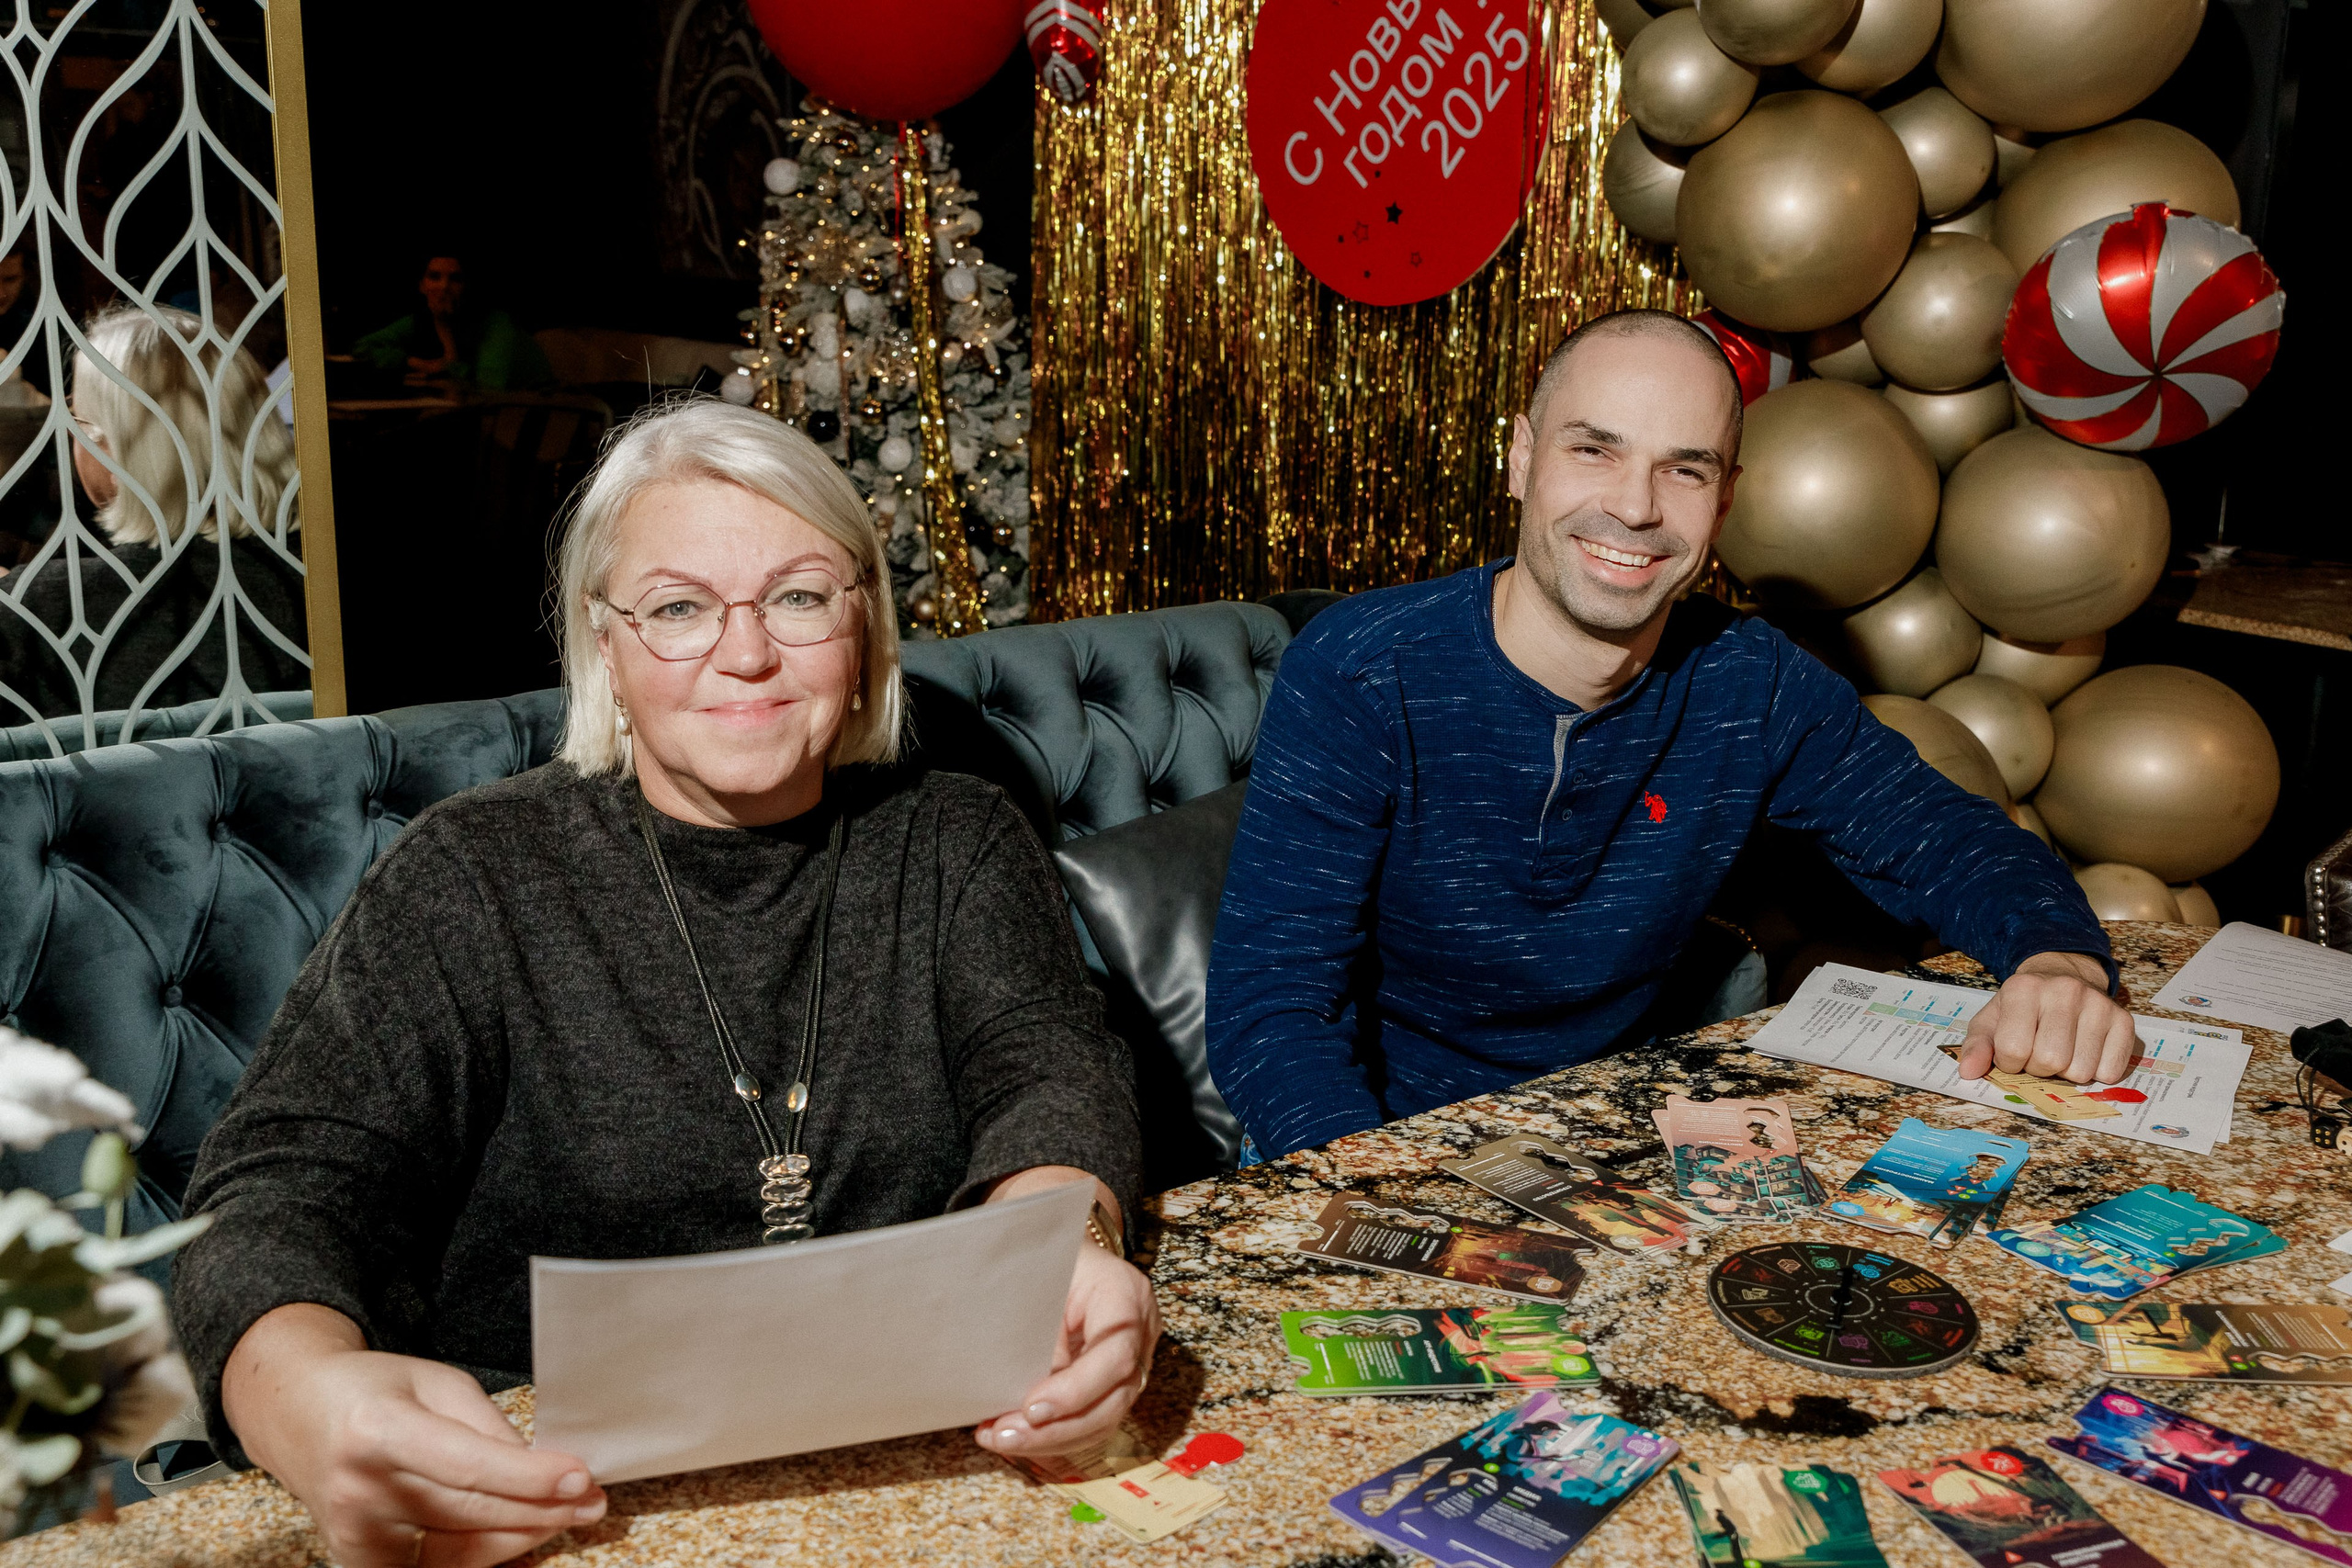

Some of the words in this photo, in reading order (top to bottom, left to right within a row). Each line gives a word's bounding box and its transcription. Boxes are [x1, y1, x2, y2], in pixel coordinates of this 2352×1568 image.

[1421, 12, 1530, 179] 2025
[1284, 131, 1323, 186] С
[1873, 1166, 1935, 1185] МАШИНОСТРОЕНИЕ
